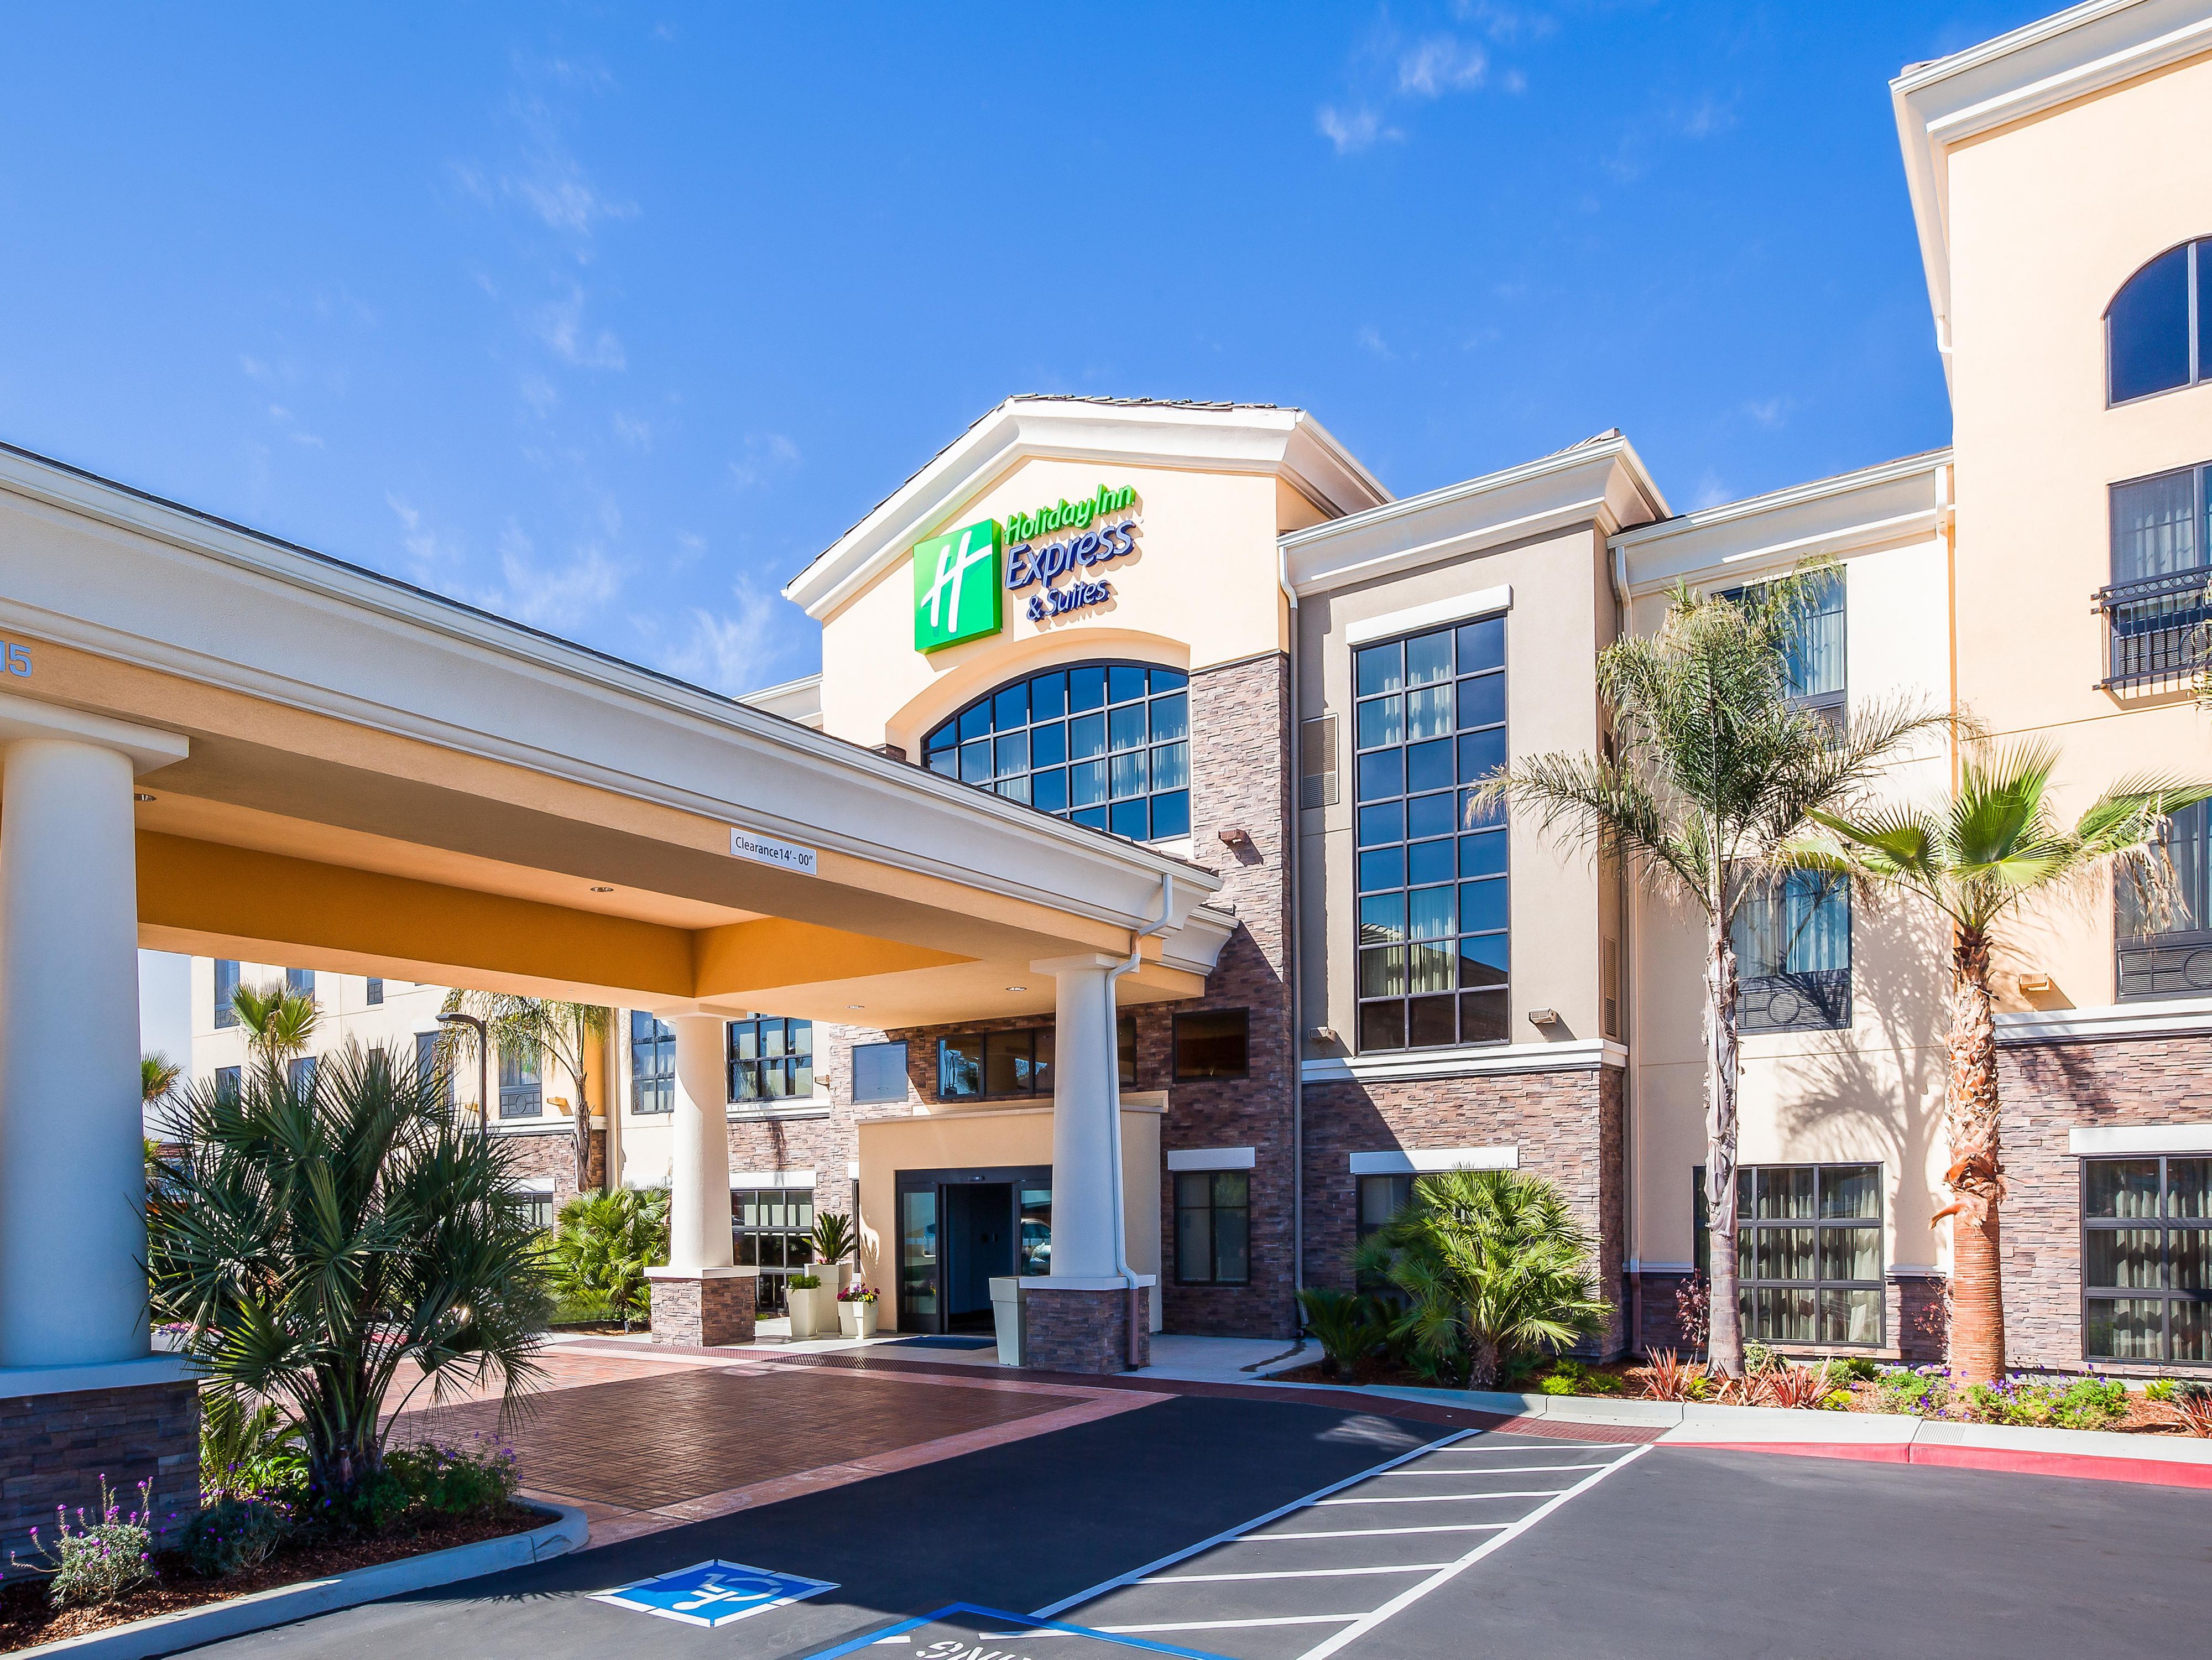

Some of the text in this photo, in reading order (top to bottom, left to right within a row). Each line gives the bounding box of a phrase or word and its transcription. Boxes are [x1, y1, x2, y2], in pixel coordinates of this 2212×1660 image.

[1004, 483, 1135, 545] Holiday Inn
[1005, 520, 1136, 590] Express
[1026, 579, 1110, 622] & Suites
[735, 836, 779, 858] Clearance
